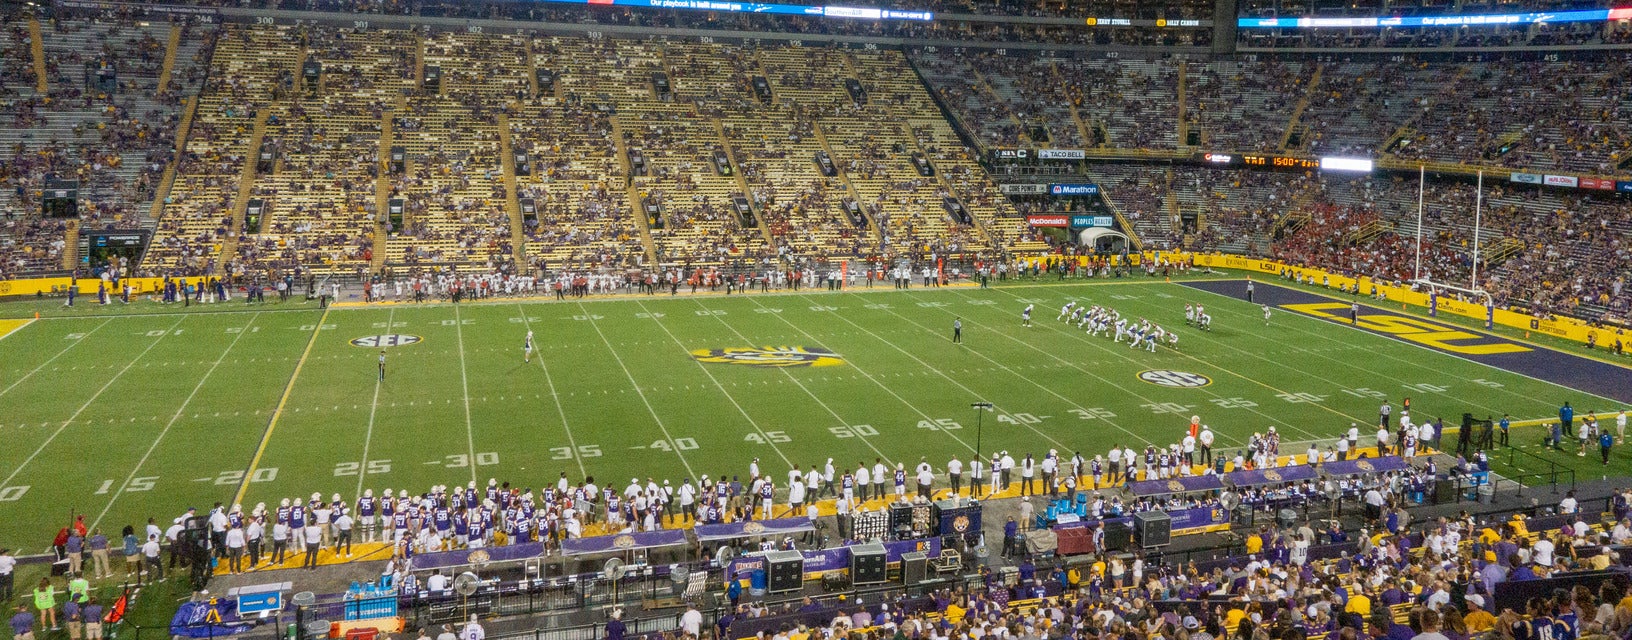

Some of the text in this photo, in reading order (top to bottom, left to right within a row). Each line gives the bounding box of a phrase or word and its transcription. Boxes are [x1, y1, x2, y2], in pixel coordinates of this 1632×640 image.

[256, 16, 274, 24] 300
[1273, 157, 1294, 166] 15:00
[1063, 186, 1097, 194] Marathon
[1260, 262, 1276, 272] LSU
[355, 335, 420, 347] SEC
[1141, 370, 1208, 387] SEC
[997, 412, 1043, 425] 40
[1067, 406, 1117, 419] 35
[916, 417, 963, 431] 45
[744, 430, 792, 445] 45
[828, 424, 880, 438] 50
[650, 436, 699, 452] 40
[549, 444, 603, 461] 35
[446, 451, 500, 469] 30
[333, 458, 392, 477] 25
[215, 467, 279, 486] 20
[94, 476, 160, 495] 15
[763, 487, 772, 496] 34
[362, 501, 371, 510] 75
[470, 526, 480, 536] 77
[1299, 547, 1307, 557] 10
